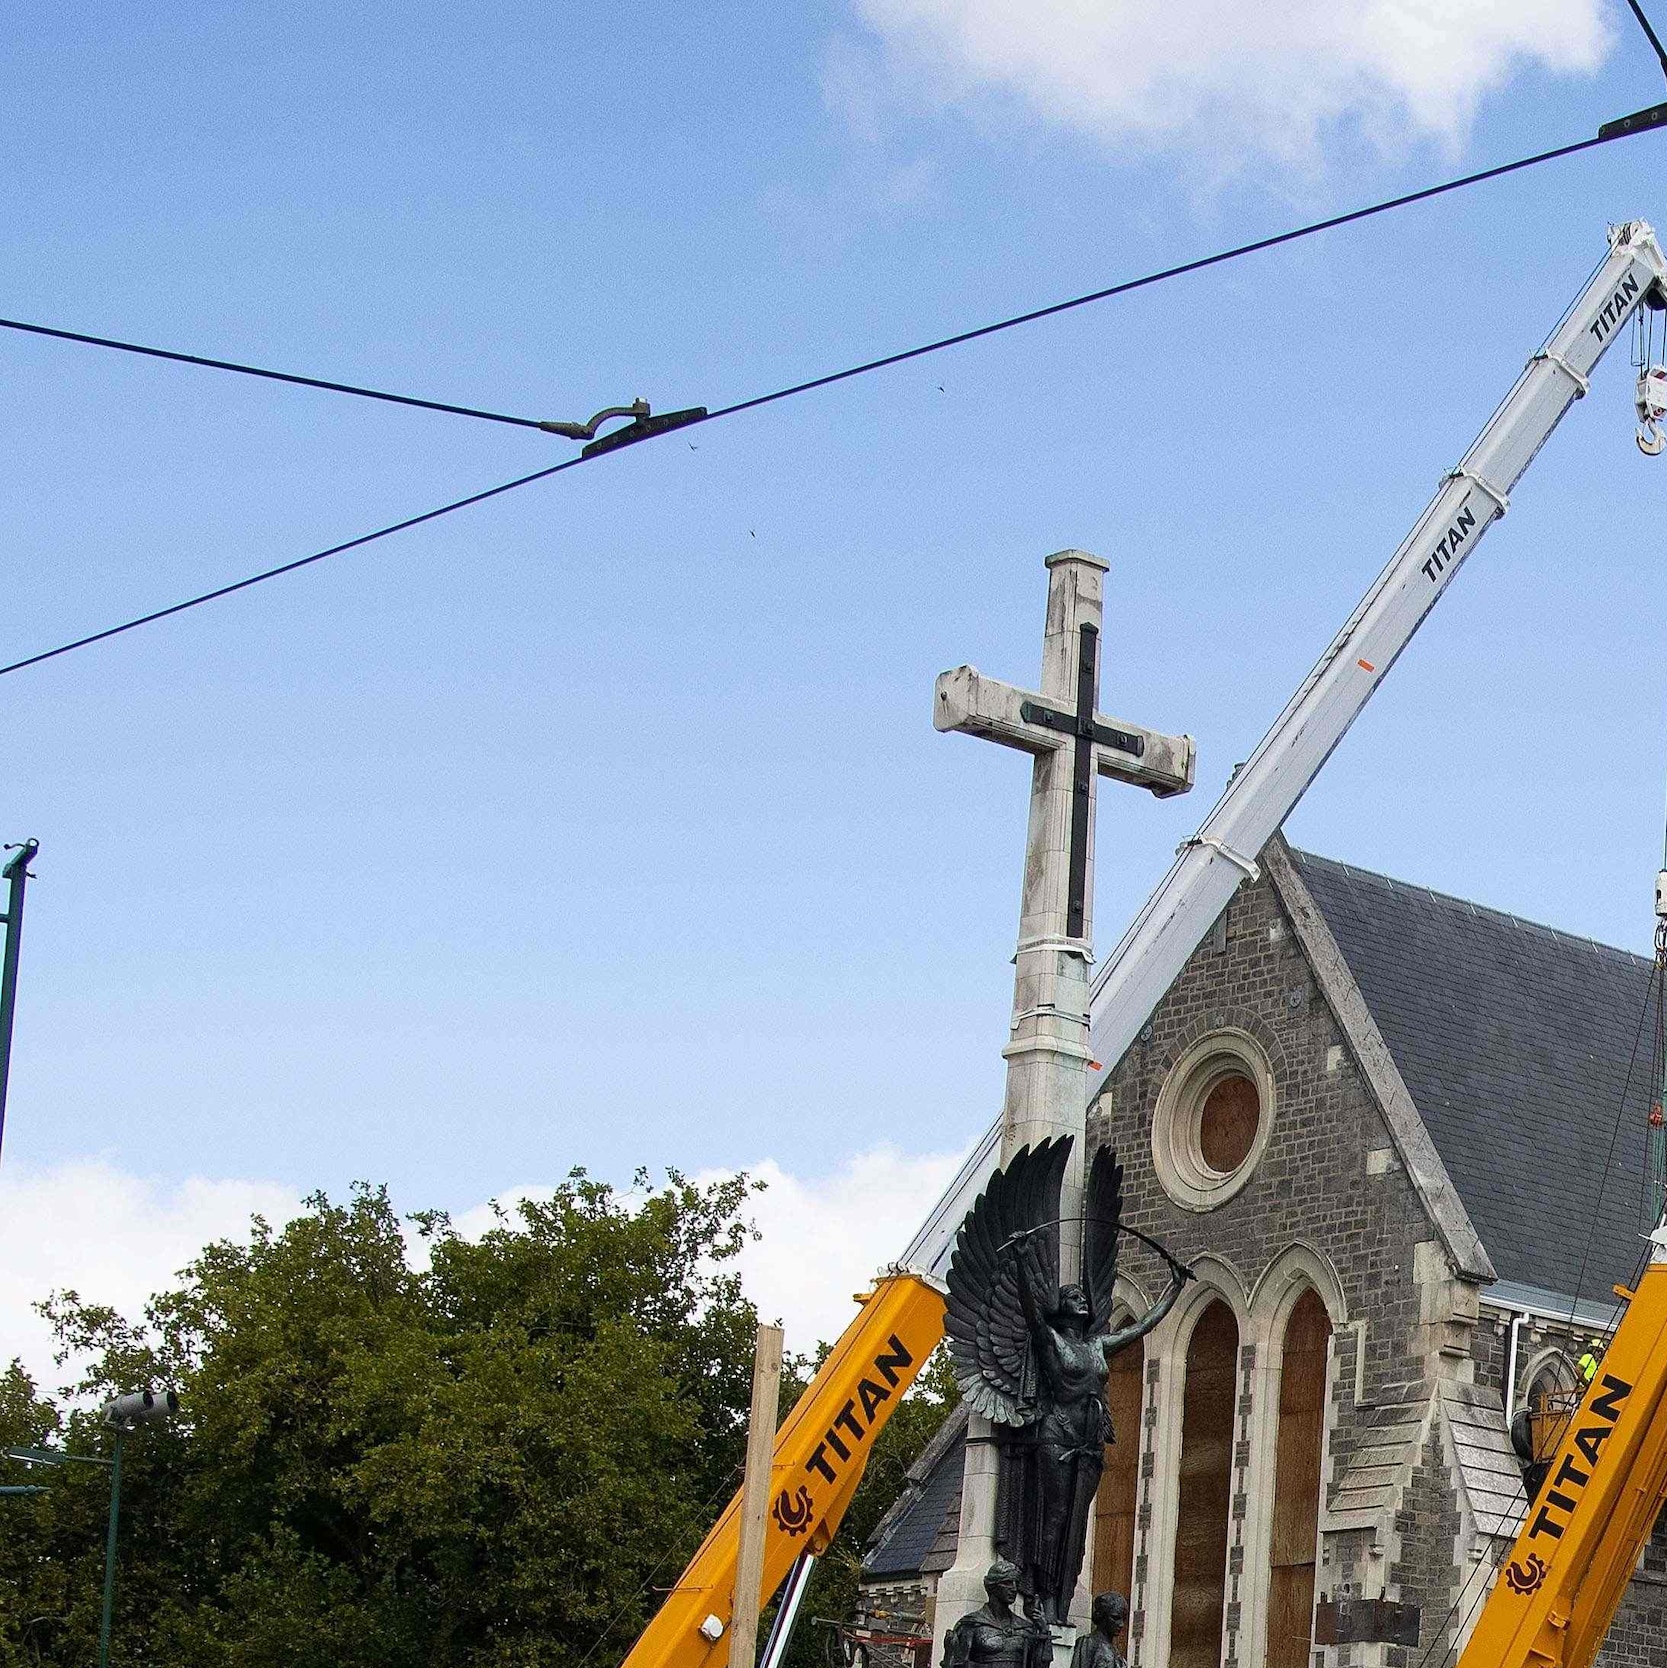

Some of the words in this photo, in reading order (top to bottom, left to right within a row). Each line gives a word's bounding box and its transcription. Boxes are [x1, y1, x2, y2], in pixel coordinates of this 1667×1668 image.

[1588, 271, 1640, 345] TITAN
[1420, 505, 1478, 585] TITAN
[804, 1332, 914, 1485] TITAN
[1529, 1371, 1634, 1543] TITAN
